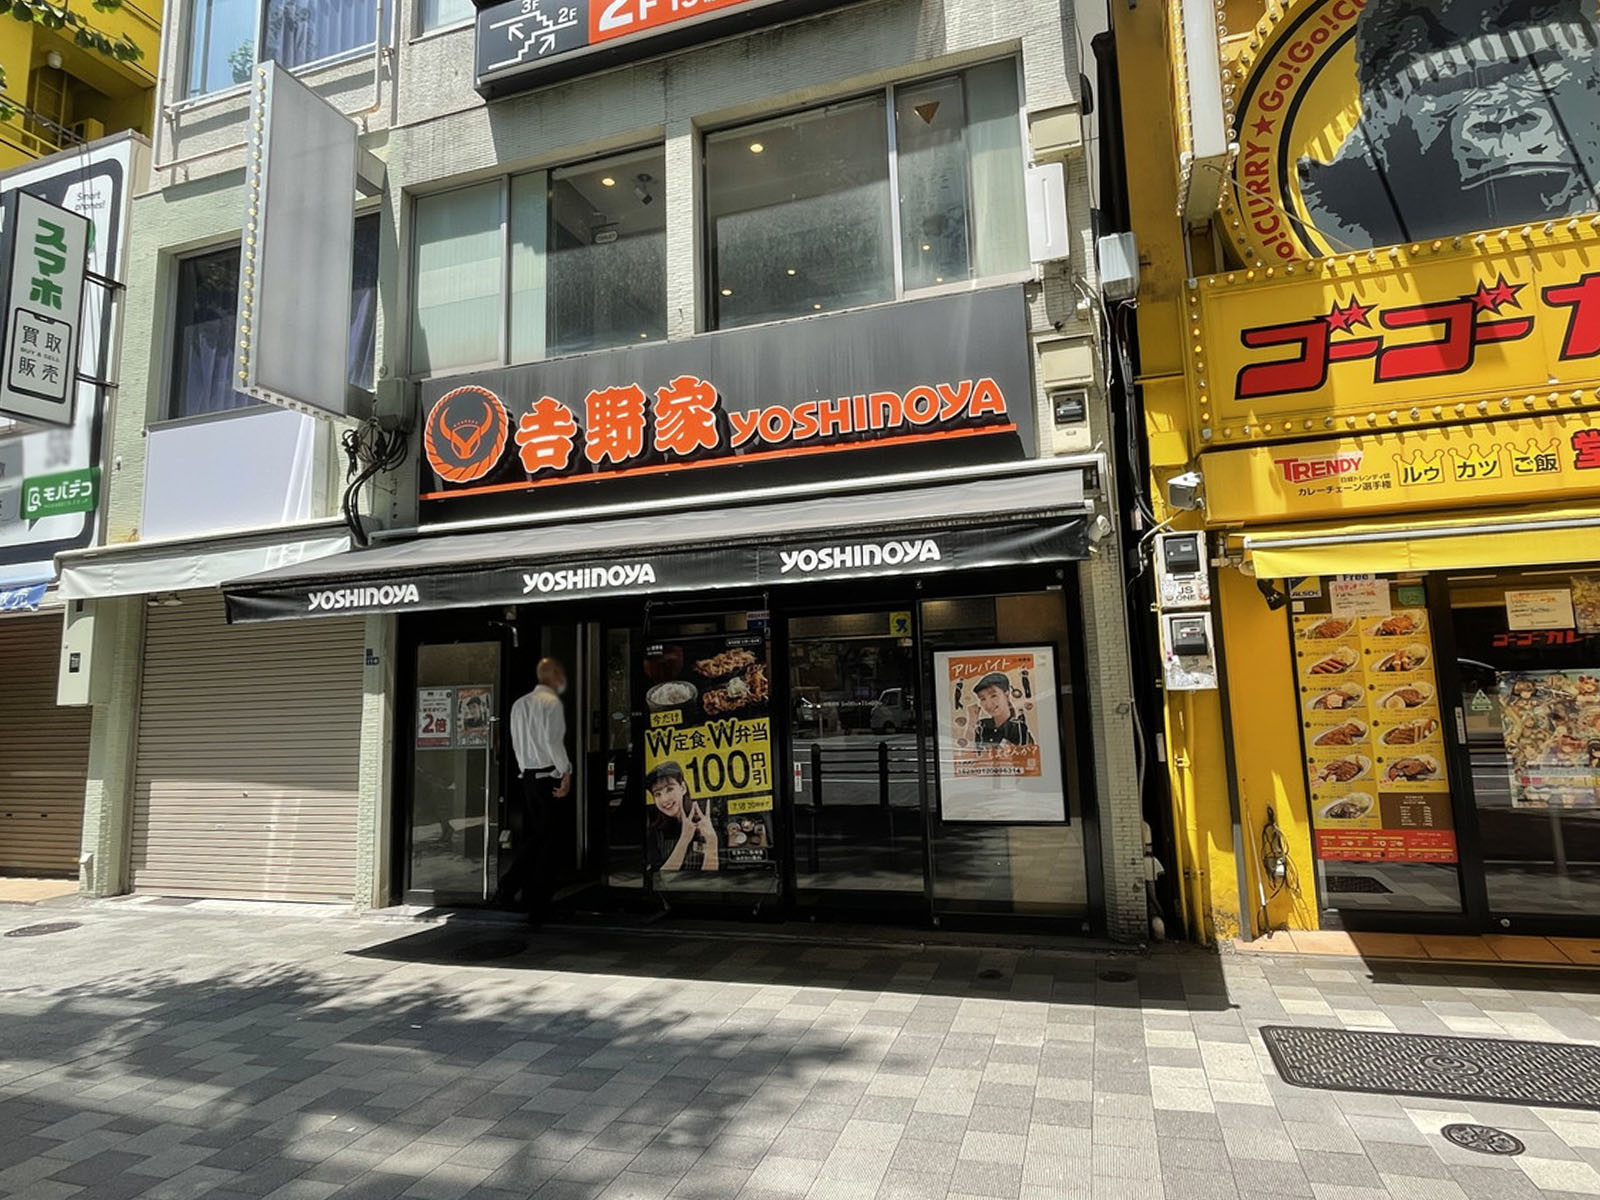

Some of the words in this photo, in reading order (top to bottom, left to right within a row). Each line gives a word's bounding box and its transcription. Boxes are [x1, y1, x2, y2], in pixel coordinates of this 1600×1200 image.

[520, 0, 539, 14] 3F
[557, 7, 577, 24] 2F
[1244, 140, 1303, 263] o!CURRY
[29, 218, 68, 310] スマホ
[22, 325, 62, 354] 買取
[18, 356, 59, 384] 販売
[515, 375, 719, 474] 吉野家
[729, 377, 1007, 449] YOSHINOYA
[1274, 456, 1363, 484] TRENDY
[1457, 460, 1497, 479] カツ
[1514, 453, 1559, 473] ご飯
[43, 479, 93, 502] モバデコ
[780, 539, 942, 574] YOSHINOYA
[522, 563, 656, 594] YOSHINOYA
[307, 584, 420, 611] YOSHINOYA
[951, 658, 1011, 678] アルバイト
